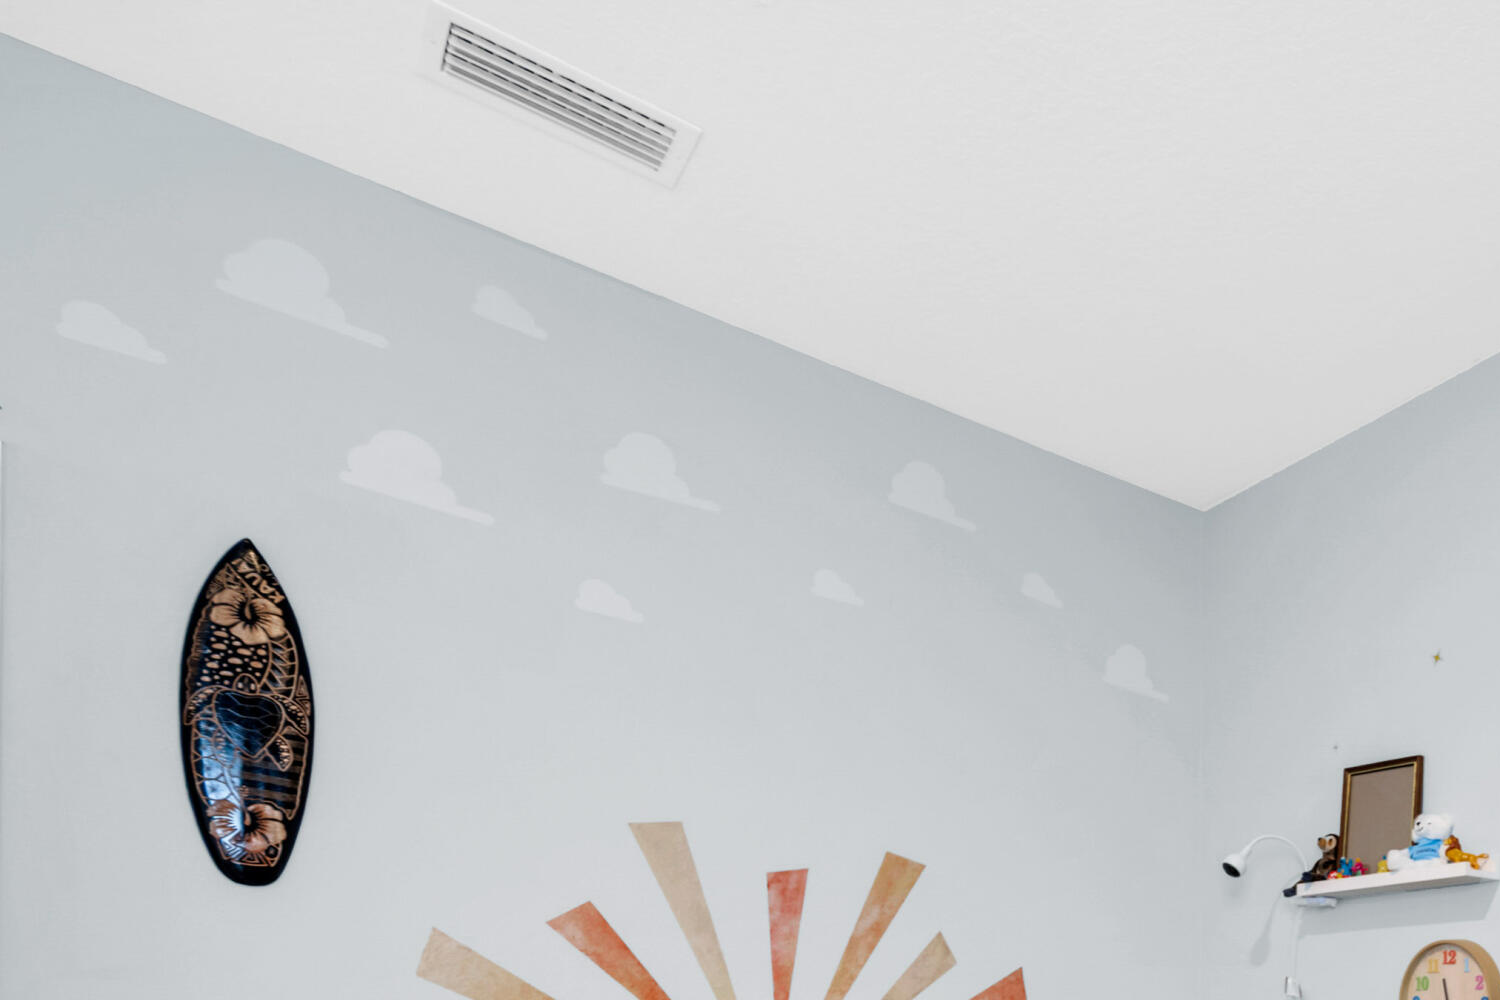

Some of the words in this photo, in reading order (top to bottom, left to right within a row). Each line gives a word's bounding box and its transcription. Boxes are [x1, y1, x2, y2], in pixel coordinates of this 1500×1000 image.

[1442, 950, 1457, 965] 12
[1428, 958, 1440, 973] 11
[1464, 958, 1470, 973] 1
[1415, 976, 1429, 991] 10
[1475, 975, 1484, 990] 2
